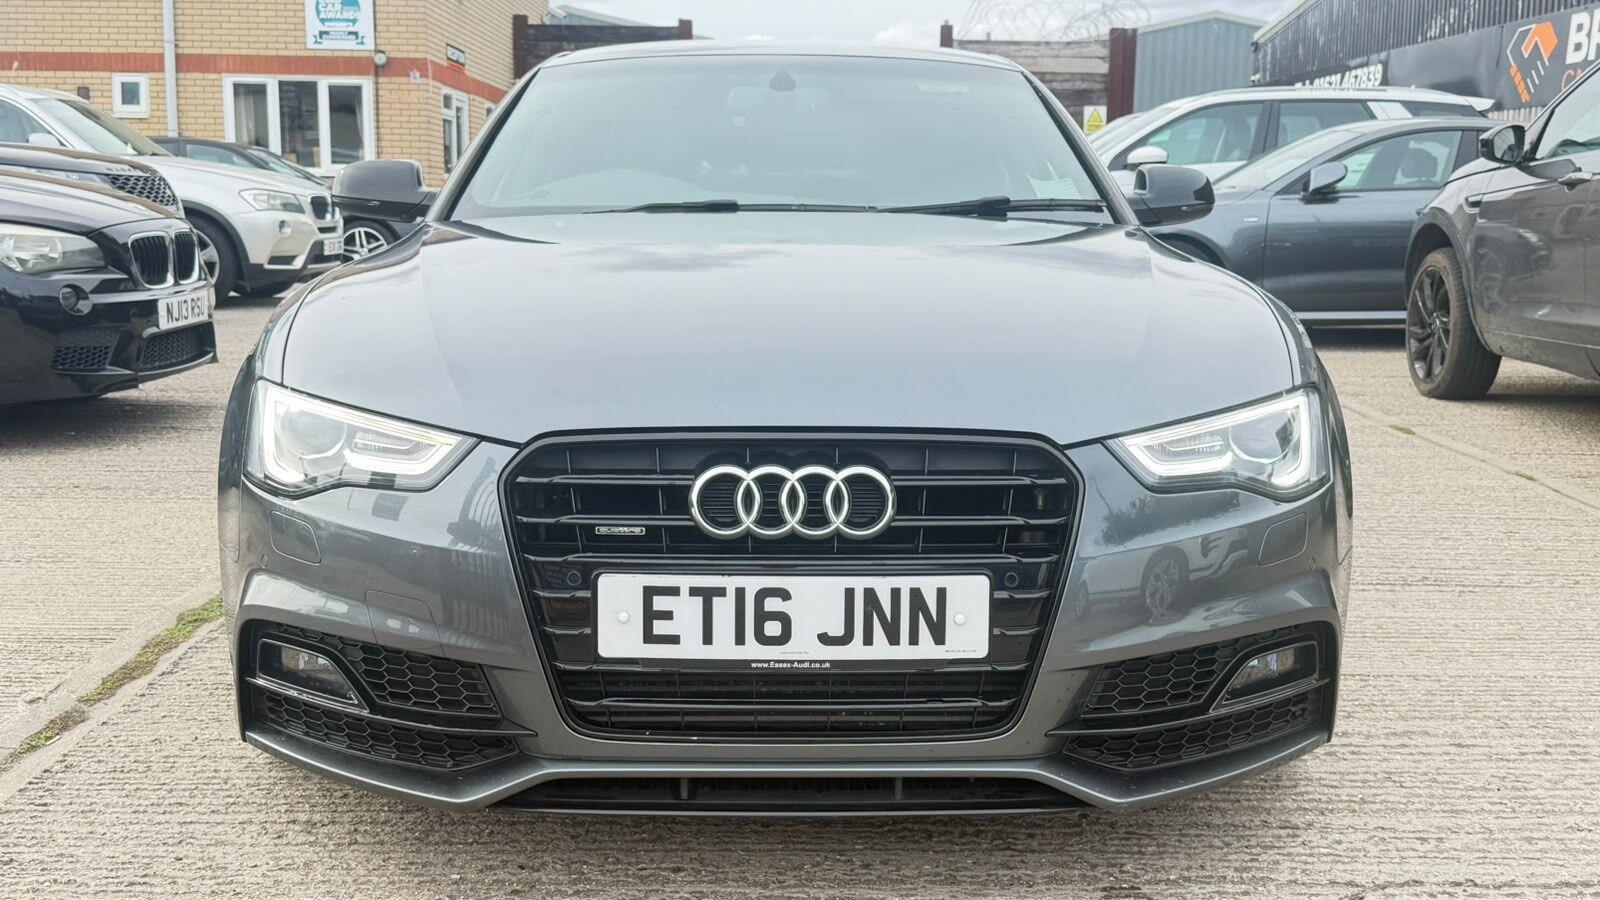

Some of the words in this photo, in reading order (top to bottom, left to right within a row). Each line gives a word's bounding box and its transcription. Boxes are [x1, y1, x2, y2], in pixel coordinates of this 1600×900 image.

[1341, 63, 1383, 89] 467839
[166, 299, 189, 324] NJ13
[190, 295, 205, 319] RSU
[642, 585, 792, 647] ET16
[816, 586, 947, 647] JNN
[750, 660, 831, 670] www.Essex-Audi.co.uk
